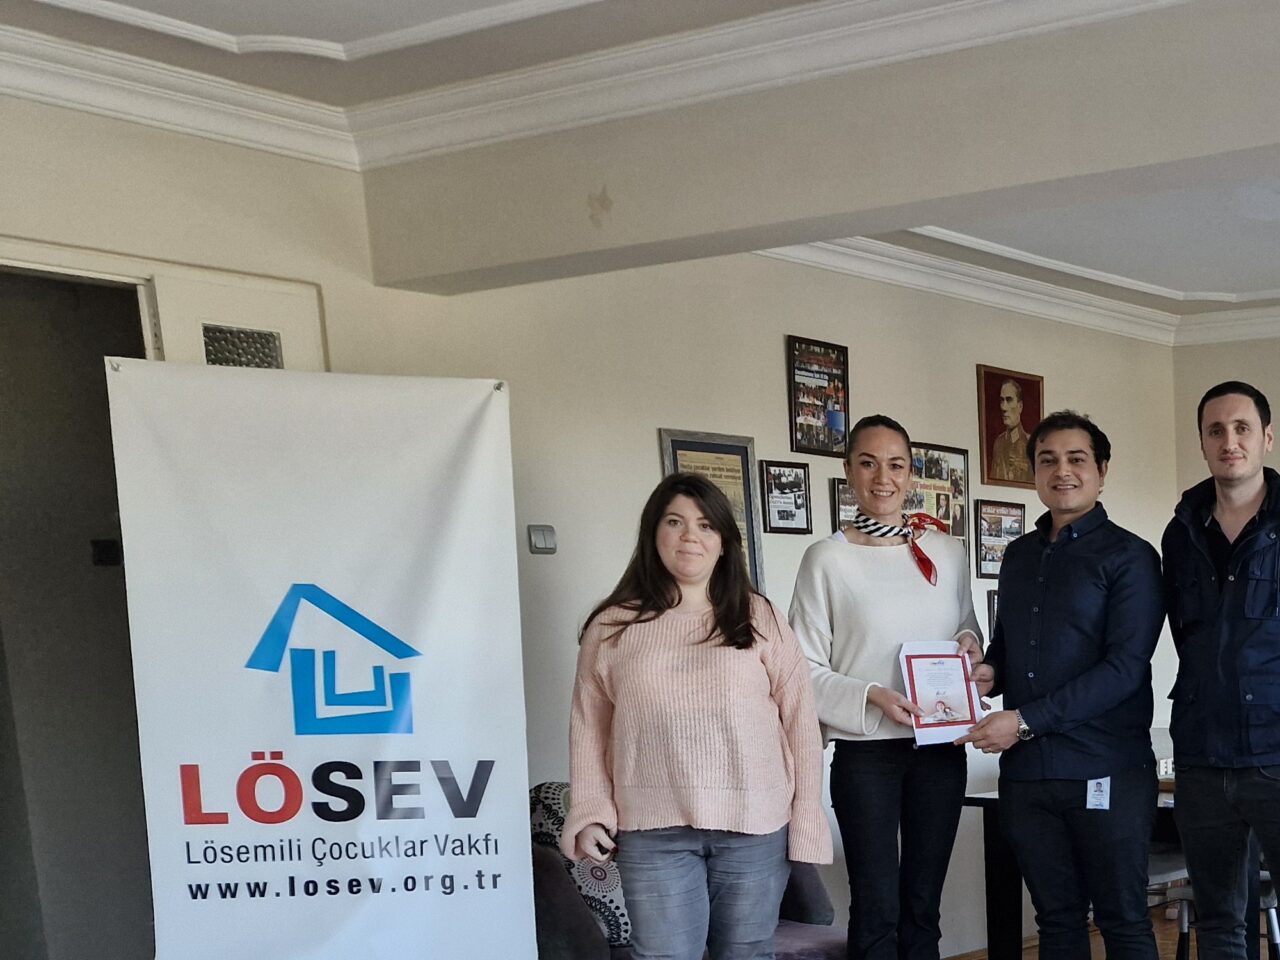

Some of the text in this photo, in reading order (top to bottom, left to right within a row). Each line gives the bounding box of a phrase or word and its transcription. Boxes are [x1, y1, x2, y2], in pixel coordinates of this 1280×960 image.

[179, 751, 495, 825] LÖSEV
[185, 832, 499, 866] Lösemili Çocuklar Vakfı
[187, 869, 502, 900] www.losev.org.tr
